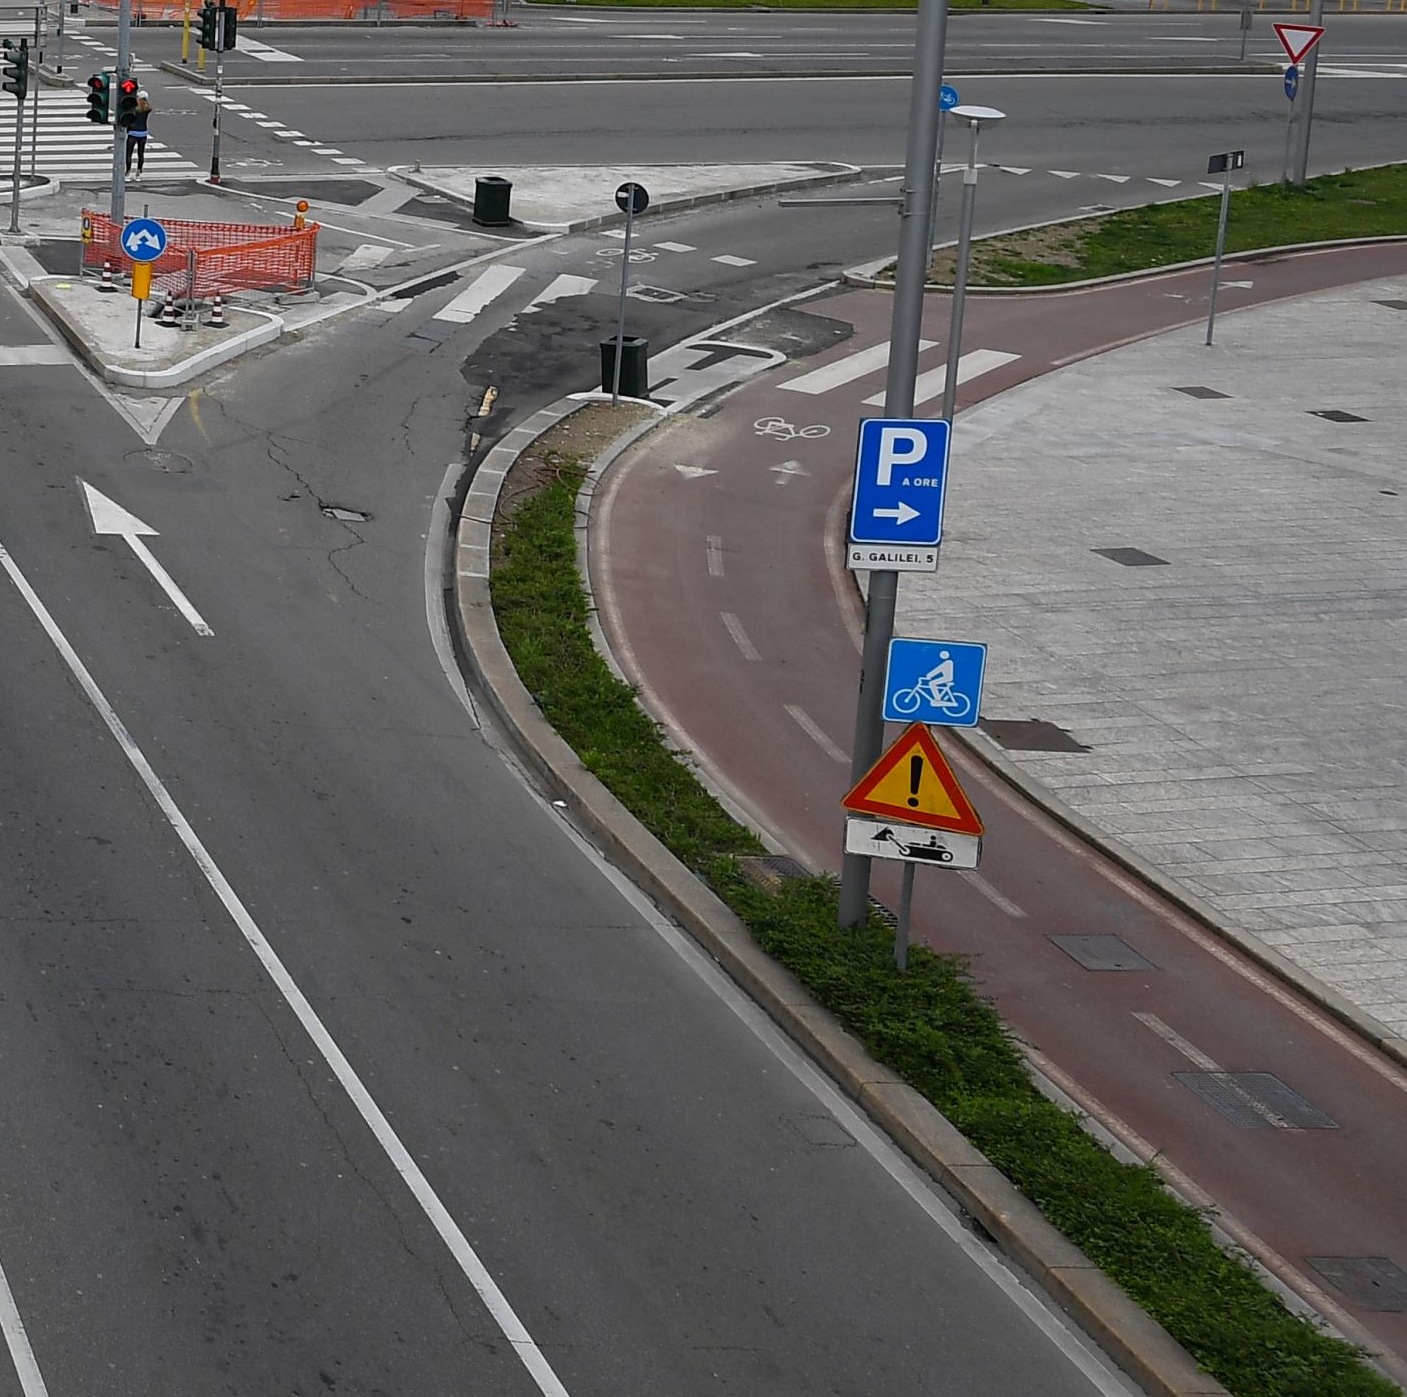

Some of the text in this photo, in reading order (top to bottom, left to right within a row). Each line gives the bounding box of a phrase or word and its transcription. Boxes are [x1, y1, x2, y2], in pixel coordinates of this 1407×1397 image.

[876, 427, 928, 486] P
[902, 477, 938, 487] A ORE
[852, 552, 865, 561] G.
[926, 554, 934, 563] 5
